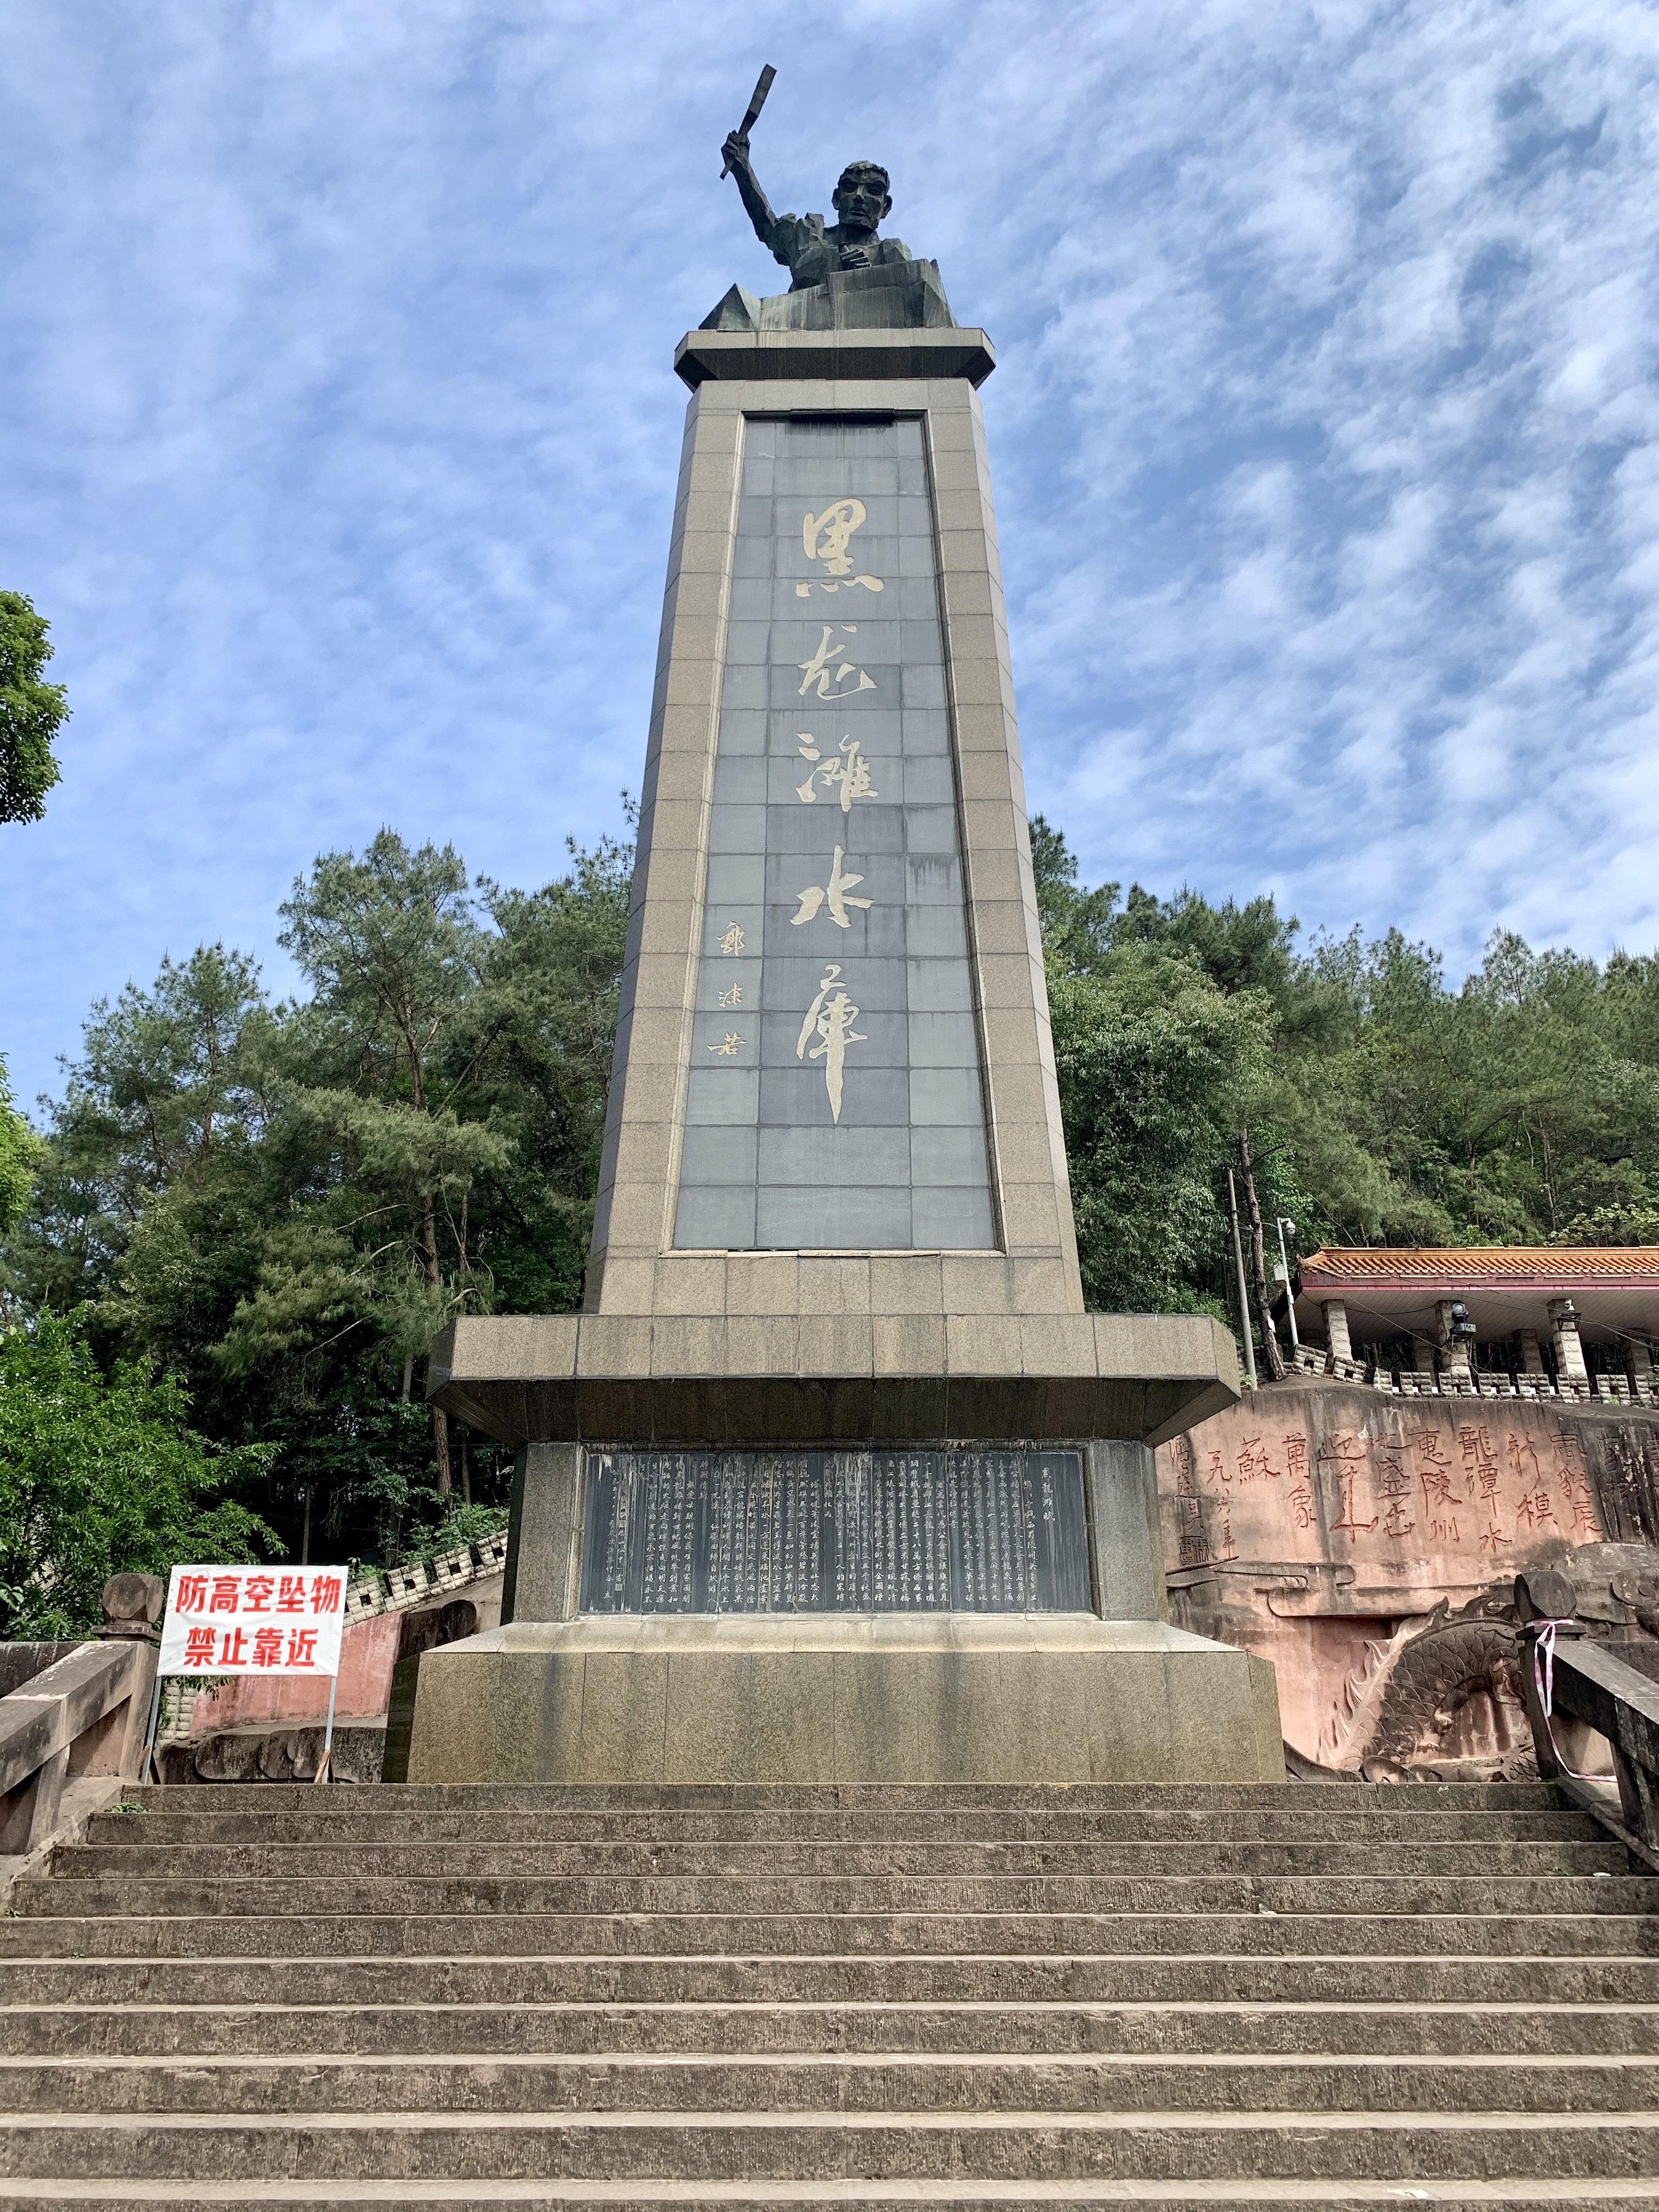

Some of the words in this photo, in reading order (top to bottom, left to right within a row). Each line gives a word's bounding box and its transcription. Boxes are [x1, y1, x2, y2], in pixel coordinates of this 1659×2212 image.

[707, 921, 747, 1056] 郭沫若
[175, 1575, 341, 1614] 防高空坠物
[184, 1627, 319, 1667] 禁止靠近
